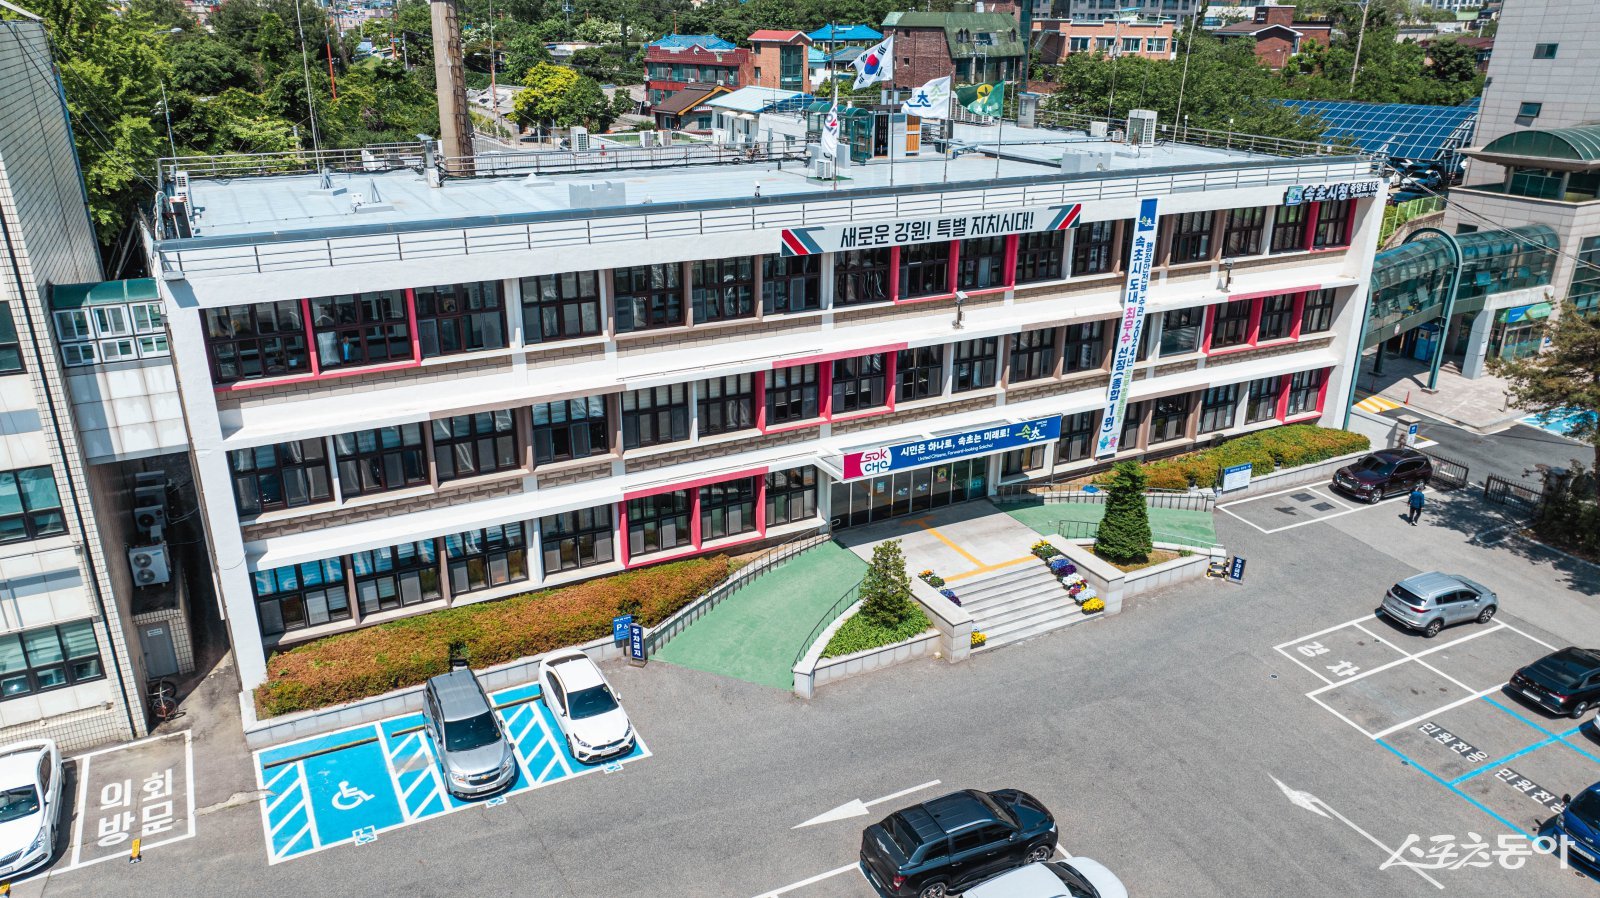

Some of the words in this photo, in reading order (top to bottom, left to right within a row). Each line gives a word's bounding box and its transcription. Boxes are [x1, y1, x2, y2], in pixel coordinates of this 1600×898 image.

[1304, 183, 1349, 202] 속초시청
[840, 225, 890, 248] 새로운
[894, 221, 931, 241] 강원!
[936, 217, 967, 238] 특별
[971, 212, 1034, 236] 자치시대!
[1131, 235, 1146, 275] 속초시
[1139, 242, 1154, 294] 행정안전부
[1127, 278, 1141, 304] 도내
[1136, 296, 1146, 317] 주관
[1121, 307, 1137, 344] 최우수
[1126, 320, 1142, 367] 2024년
[1109, 347, 1129, 402] 선정(종합
[1102, 404, 1115, 433] 1위)
[900, 442, 926, 457] 시민은
[927, 438, 956, 451] 하나로,
[958, 434, 982, 446] 속초는
[983, 428, 1010, 442] 미래로!
[616, 623, 622, 631] P
[632, 627, 641, 657] 주차금지
[1417, 722, 1489, 763] 민원전용
[100, 768, 173, 810] 의회
[97, 800, 173, 847] 방문
